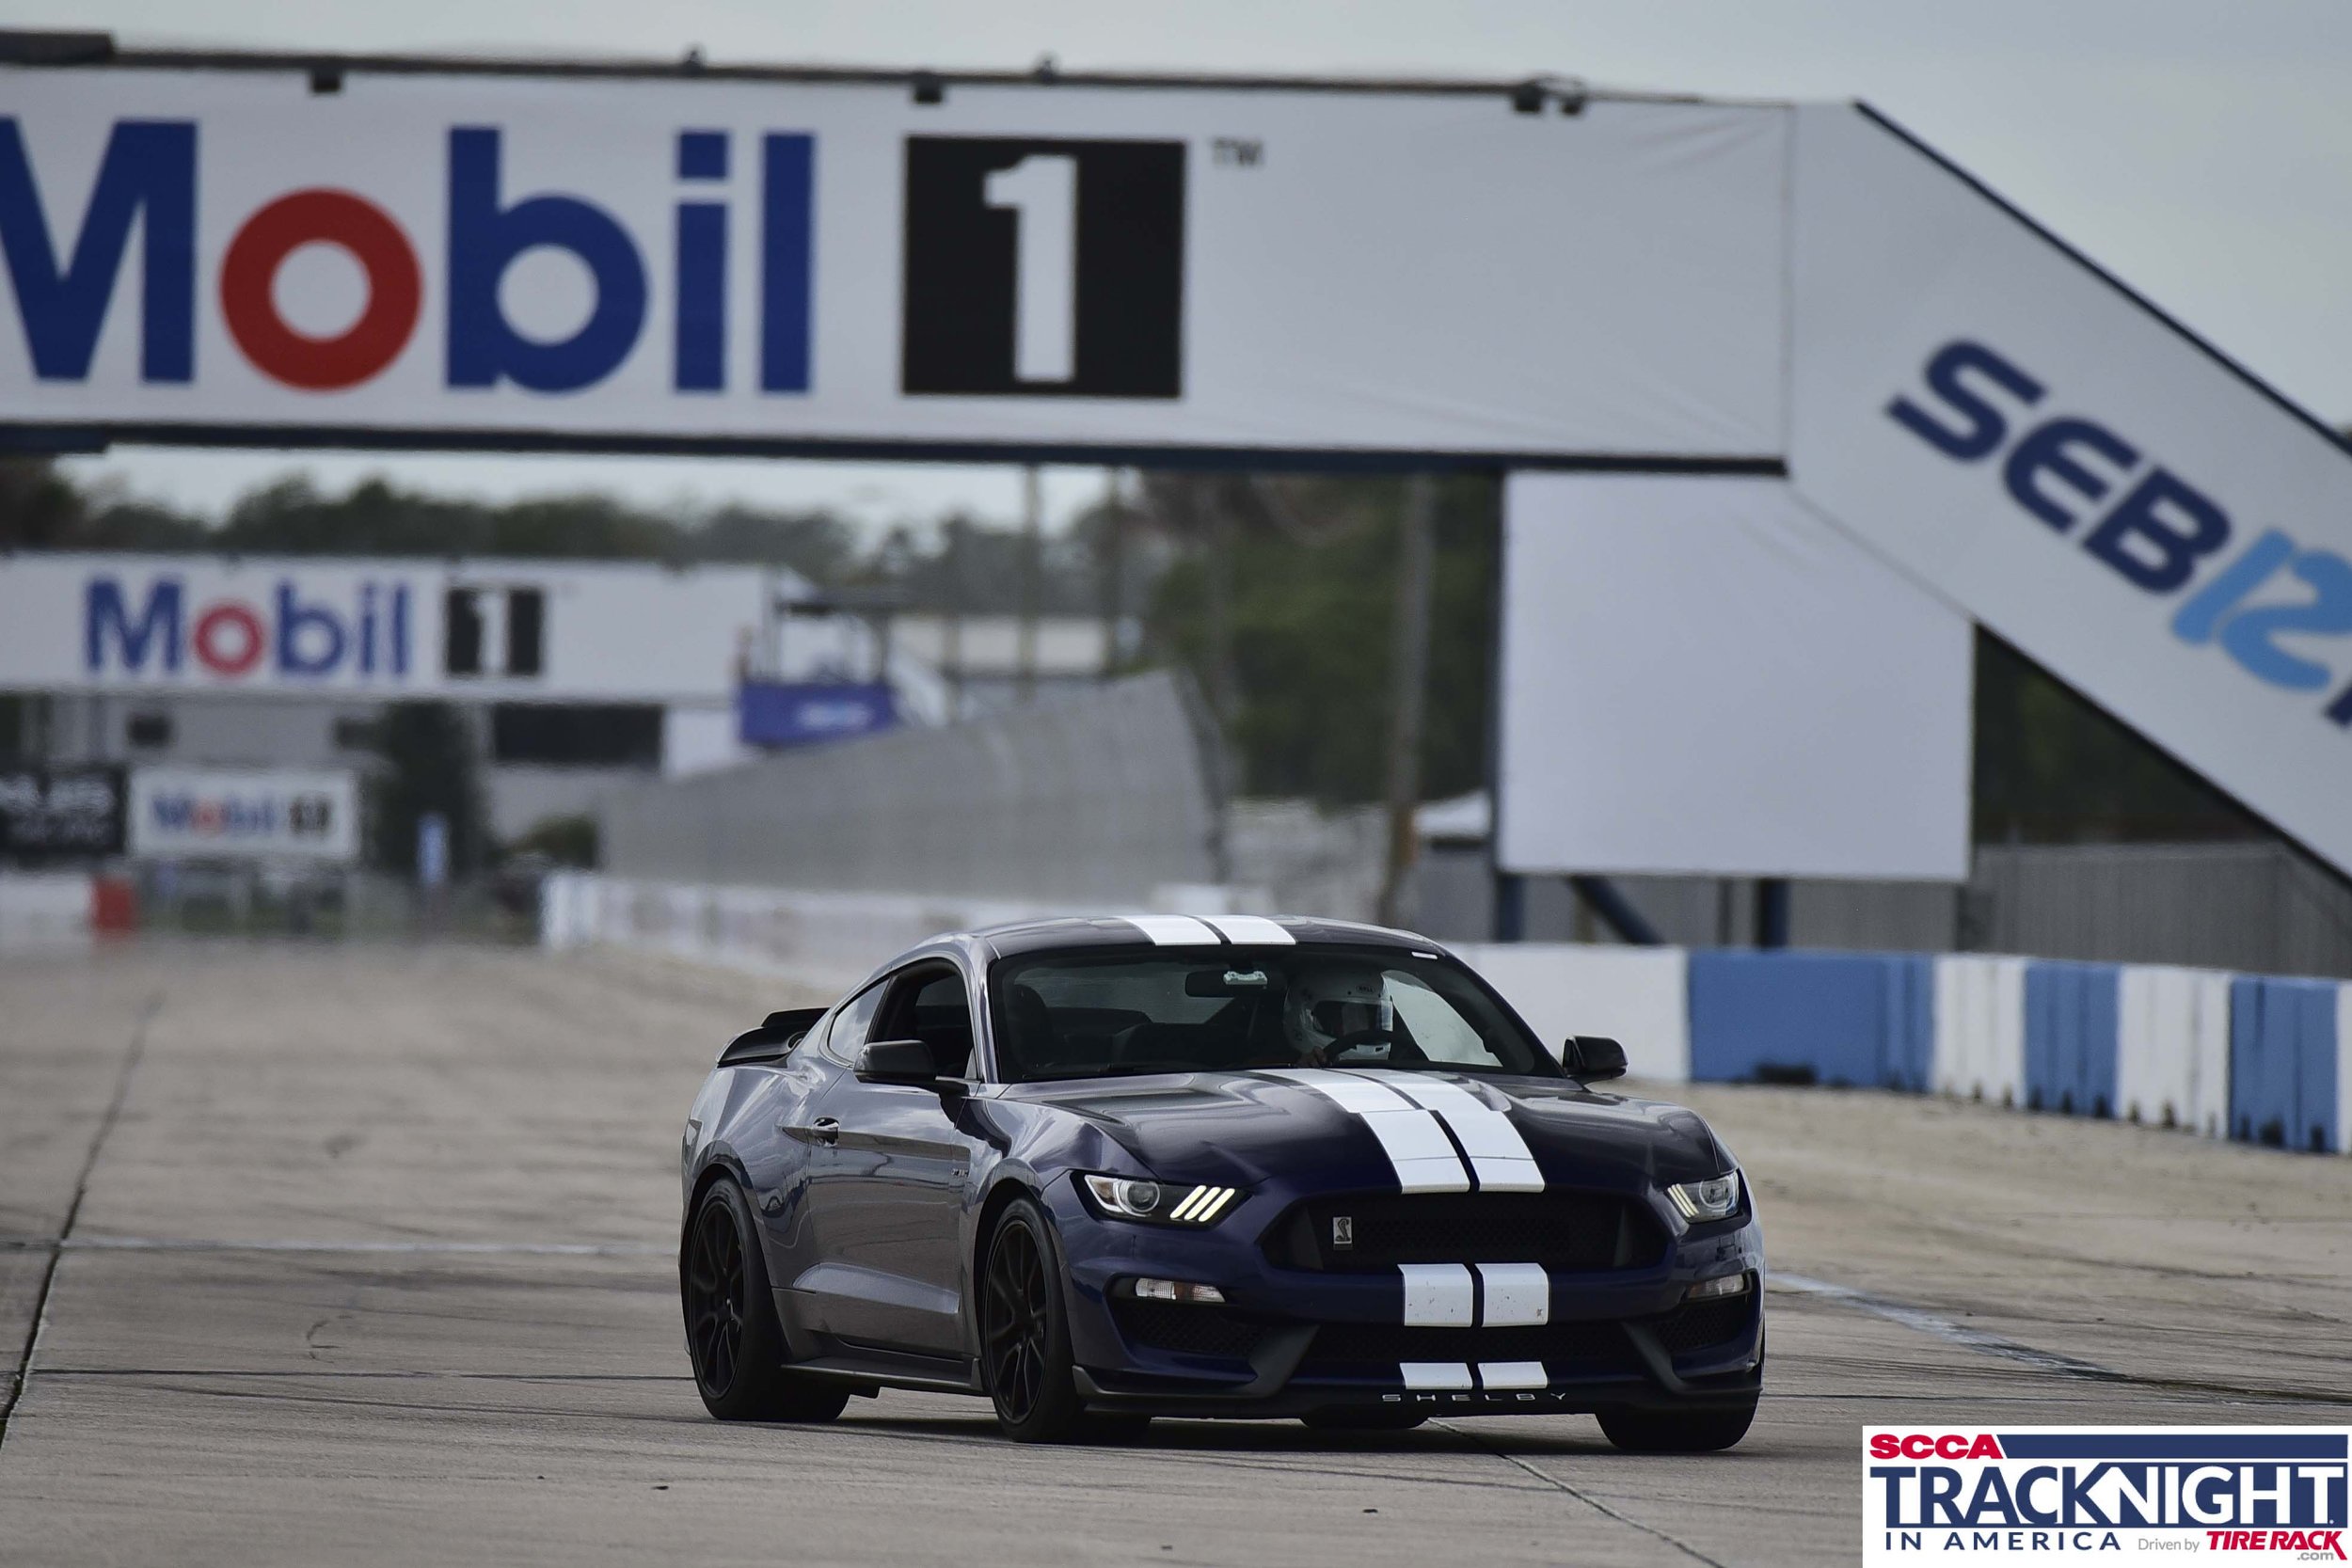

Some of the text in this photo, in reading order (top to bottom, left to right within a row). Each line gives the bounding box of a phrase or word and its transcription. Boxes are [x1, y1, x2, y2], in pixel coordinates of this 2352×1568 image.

[0, 116, 817, 395] Mobil
[982, 151, 1078, 384] 1
[85, 578, 412, 678] Mobil
[1381, 1392, 1566, 1402] SHELBY
